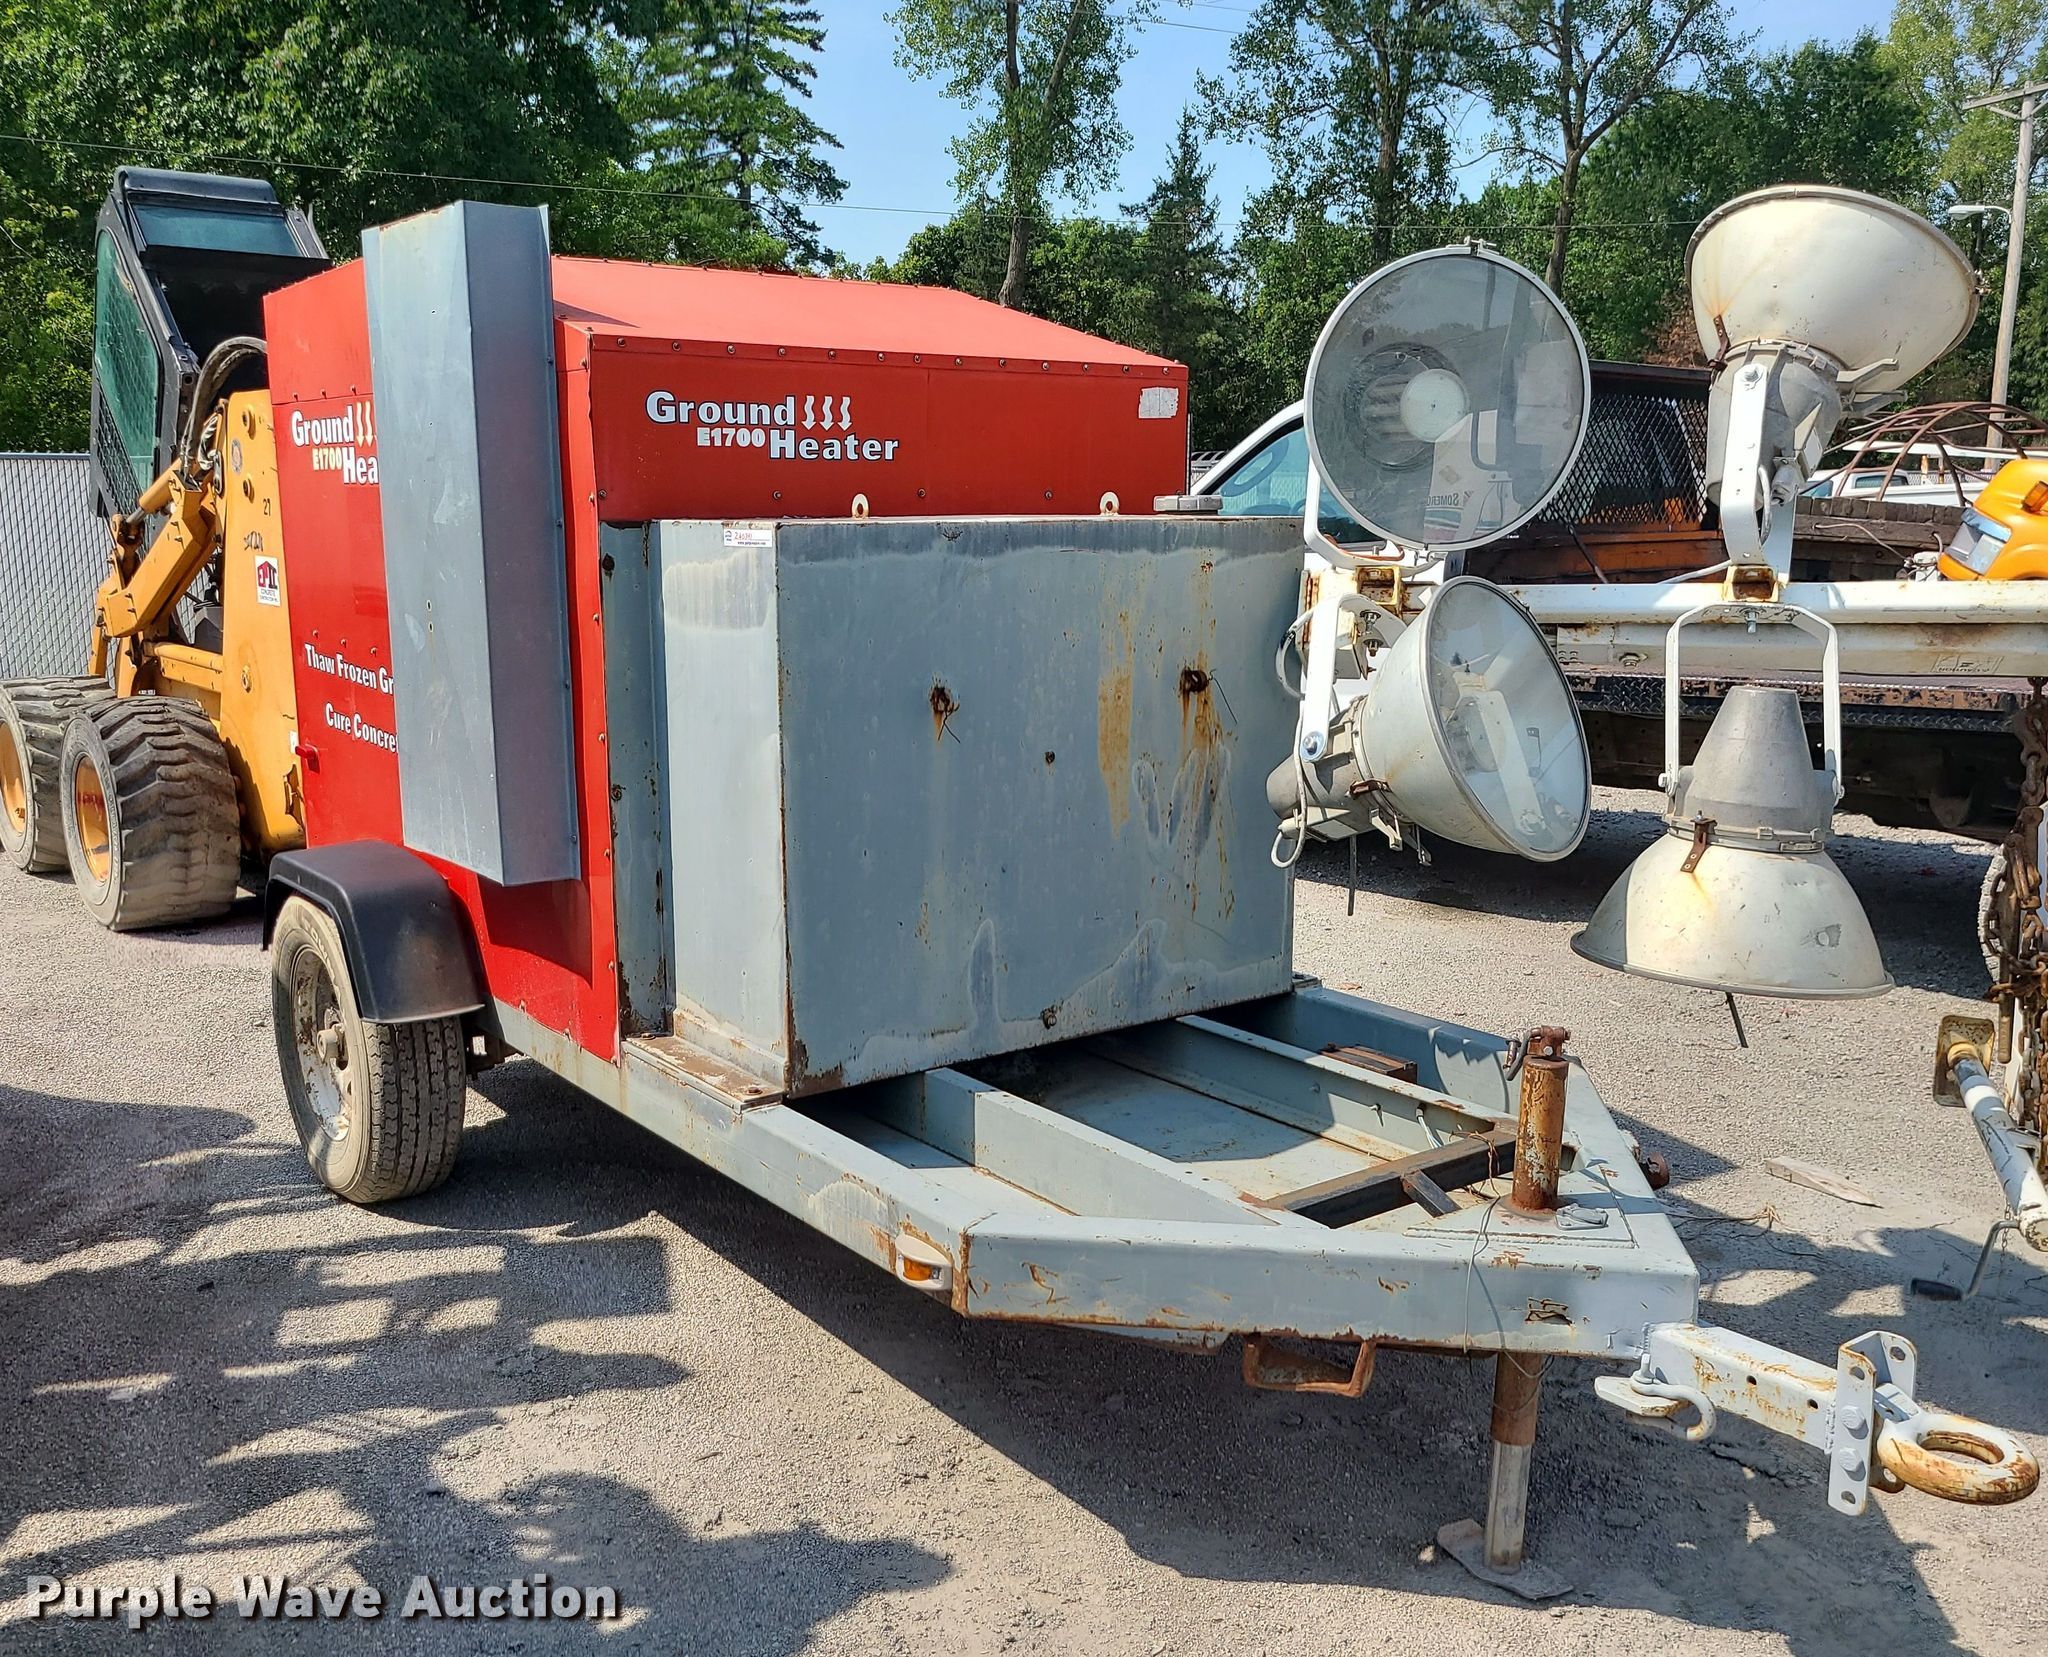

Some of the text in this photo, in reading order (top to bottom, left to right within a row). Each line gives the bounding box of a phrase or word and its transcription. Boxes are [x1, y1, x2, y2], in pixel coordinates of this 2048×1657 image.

[291, 404, 355, 447] Ground
[645, 390, 796, 427] Ground
[312, 447, 343, 471] E1700
[696, 427, 900, 461] E1700 Heater
[304, 642, 335, 676] Thaw
[336, 652, 377, 690] Frozen
[325, 702, 352, 735] Cure
